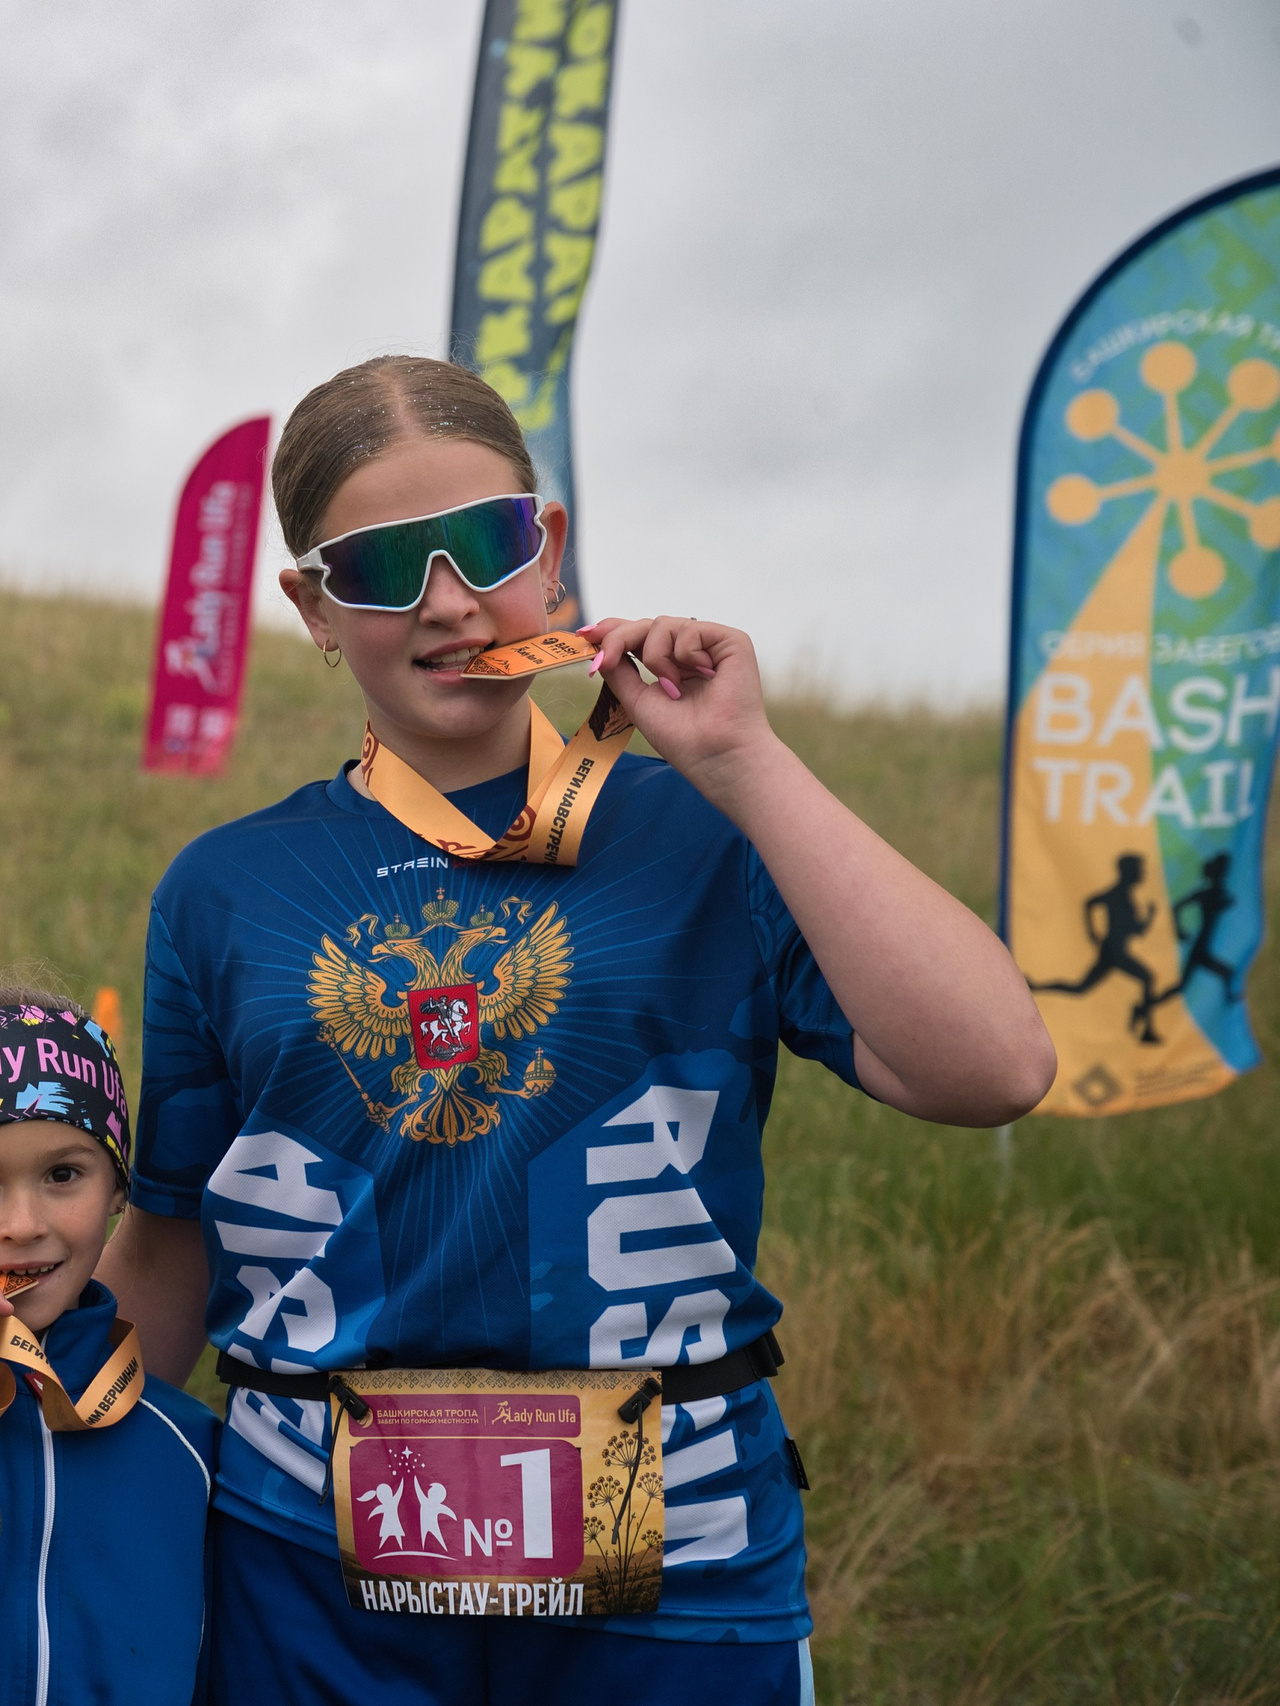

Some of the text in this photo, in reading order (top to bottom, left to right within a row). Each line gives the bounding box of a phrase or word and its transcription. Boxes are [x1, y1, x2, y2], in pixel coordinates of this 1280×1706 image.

[1033, 664, 1280, 753] BASH
[569, 757, 595, 789] БЕГИ
[376, 857, 449, 878] STREIN
[36, 1038, 98, 1088] Run
[101, 1060, 128, 1120] Ufa
[10, 1335, 44, 1360] БЕГИ
[377, 1409, 478, 1418] БАШКИРСКАЯ ТРОПА
[508, 1409, 577, 1426] Lady Run Ufa
[359, 1577, 585, 1616] НАРЫСТАУ-ТРЕЙЛ
